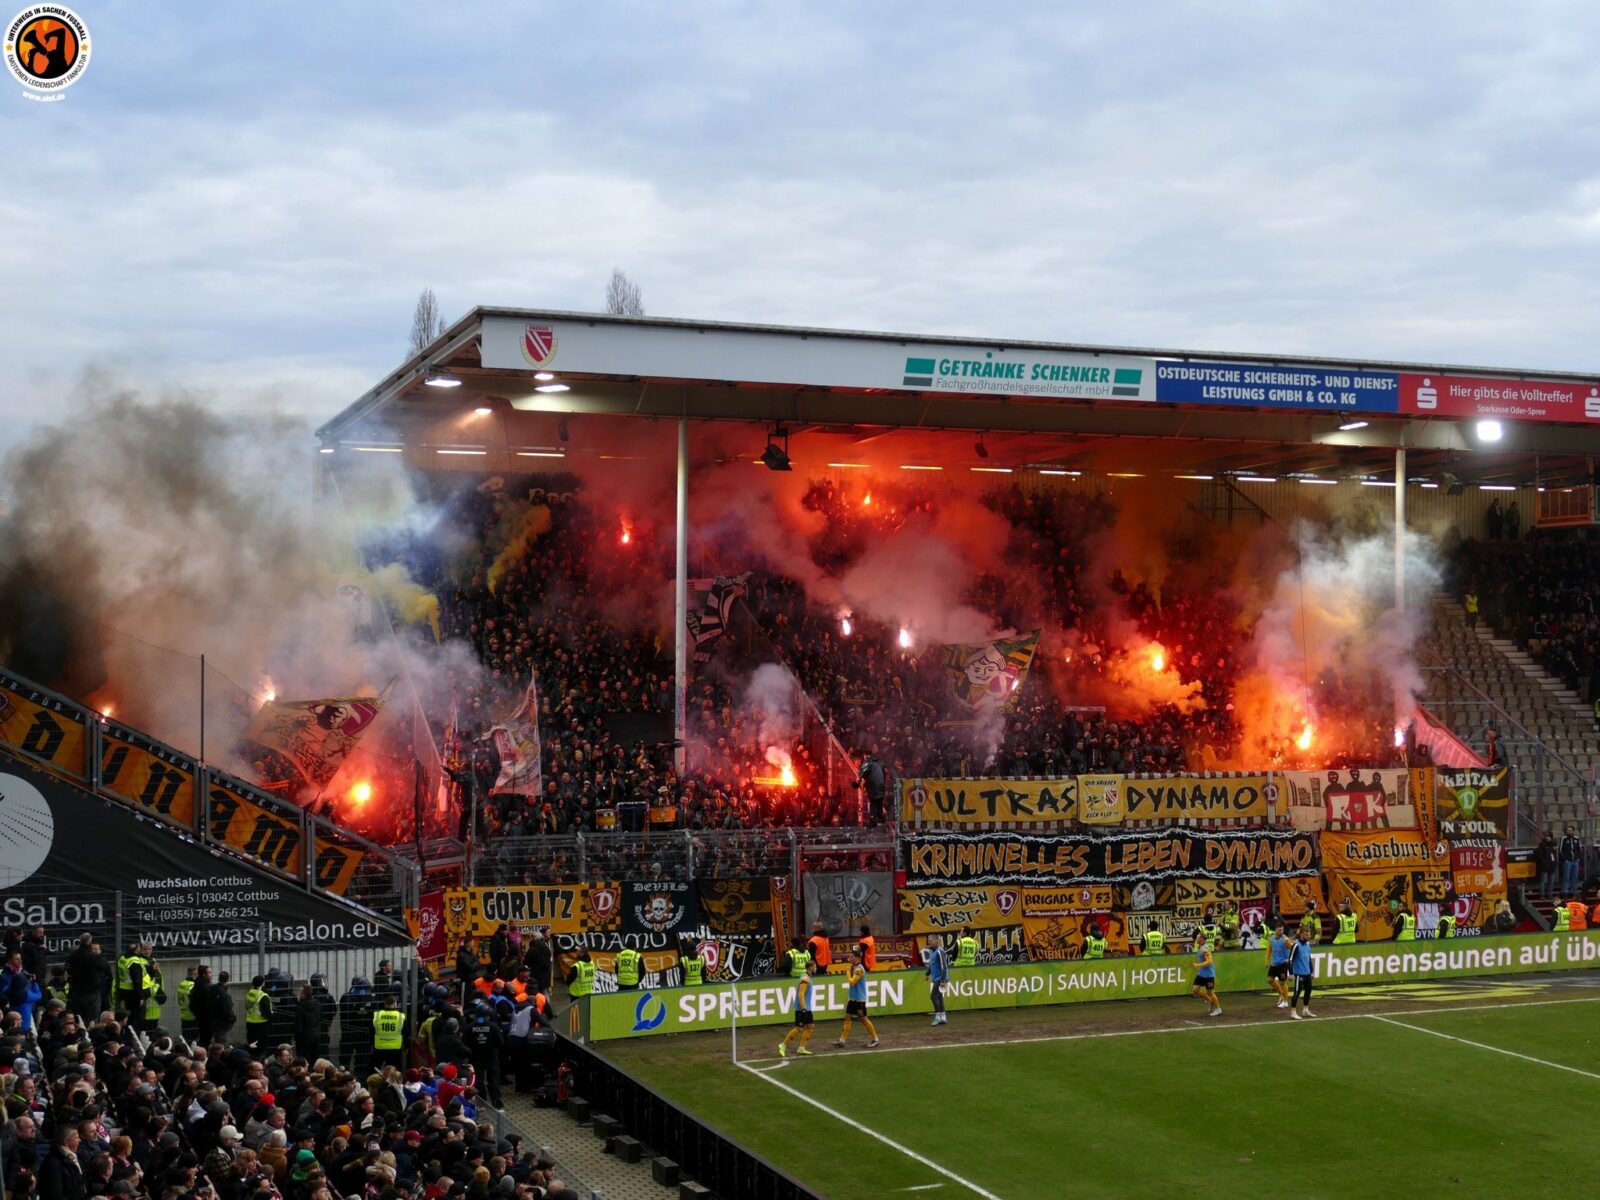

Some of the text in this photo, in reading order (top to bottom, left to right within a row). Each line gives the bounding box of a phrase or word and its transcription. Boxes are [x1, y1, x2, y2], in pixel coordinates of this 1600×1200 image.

[1031, 363, 1110, 383] SCHENKER
[1158, 366, 1398, 391] OSTDEUTSCHE SICHERHEITS- UND DIENST-
[936, 377, 1110, 396] Fachgroßhandelsgesellschaft mbH
[1202, 385, 1356, 405] LEISTUNGS GMBH & CO. KG
[1450, 384, 1574, 403] Hier gibts die Volltreffer!
[1477, 403, 1546, 416] Sparkasse Oder-Spree
[934, 786, 1076, 817] ULTRAS
[1126, 784, 1259, 813] DYNAMO
[1459, 821, 1497, 834] TOUR
[911, 838, 1312, 877] KRIMINELLES LEBEN DYNAMO
[1460, 852, 1484, 867] HASE
[137, 876, 252, 889] WaschSalon Cottbus
[633, 882, 689, 892] DEVILS
[1424, 881, 1447, 899] 53
[137, 889, 280, 905] Am Gleis 5 03042 Cottbus
[481, 887, 576, 922] GÖRLITZ
[916, 890, 989, 910] DRESDEN
[1025, 893, 1075, 905] BRIGADE
[1095, 892, 1111, 904] 53
[0, 897, 106, 927] Salon
[137, 907, 260, 922] Tel. (0355) 756 266 251
[929, 908, 981, 927] WEST
[1313, 936, 1600, 978] Themensaunen auf üb
[931, 967, 1185, 998] NGUINBAD SAUNA HOTEL
[381, 1022, 396, 1032] 186
